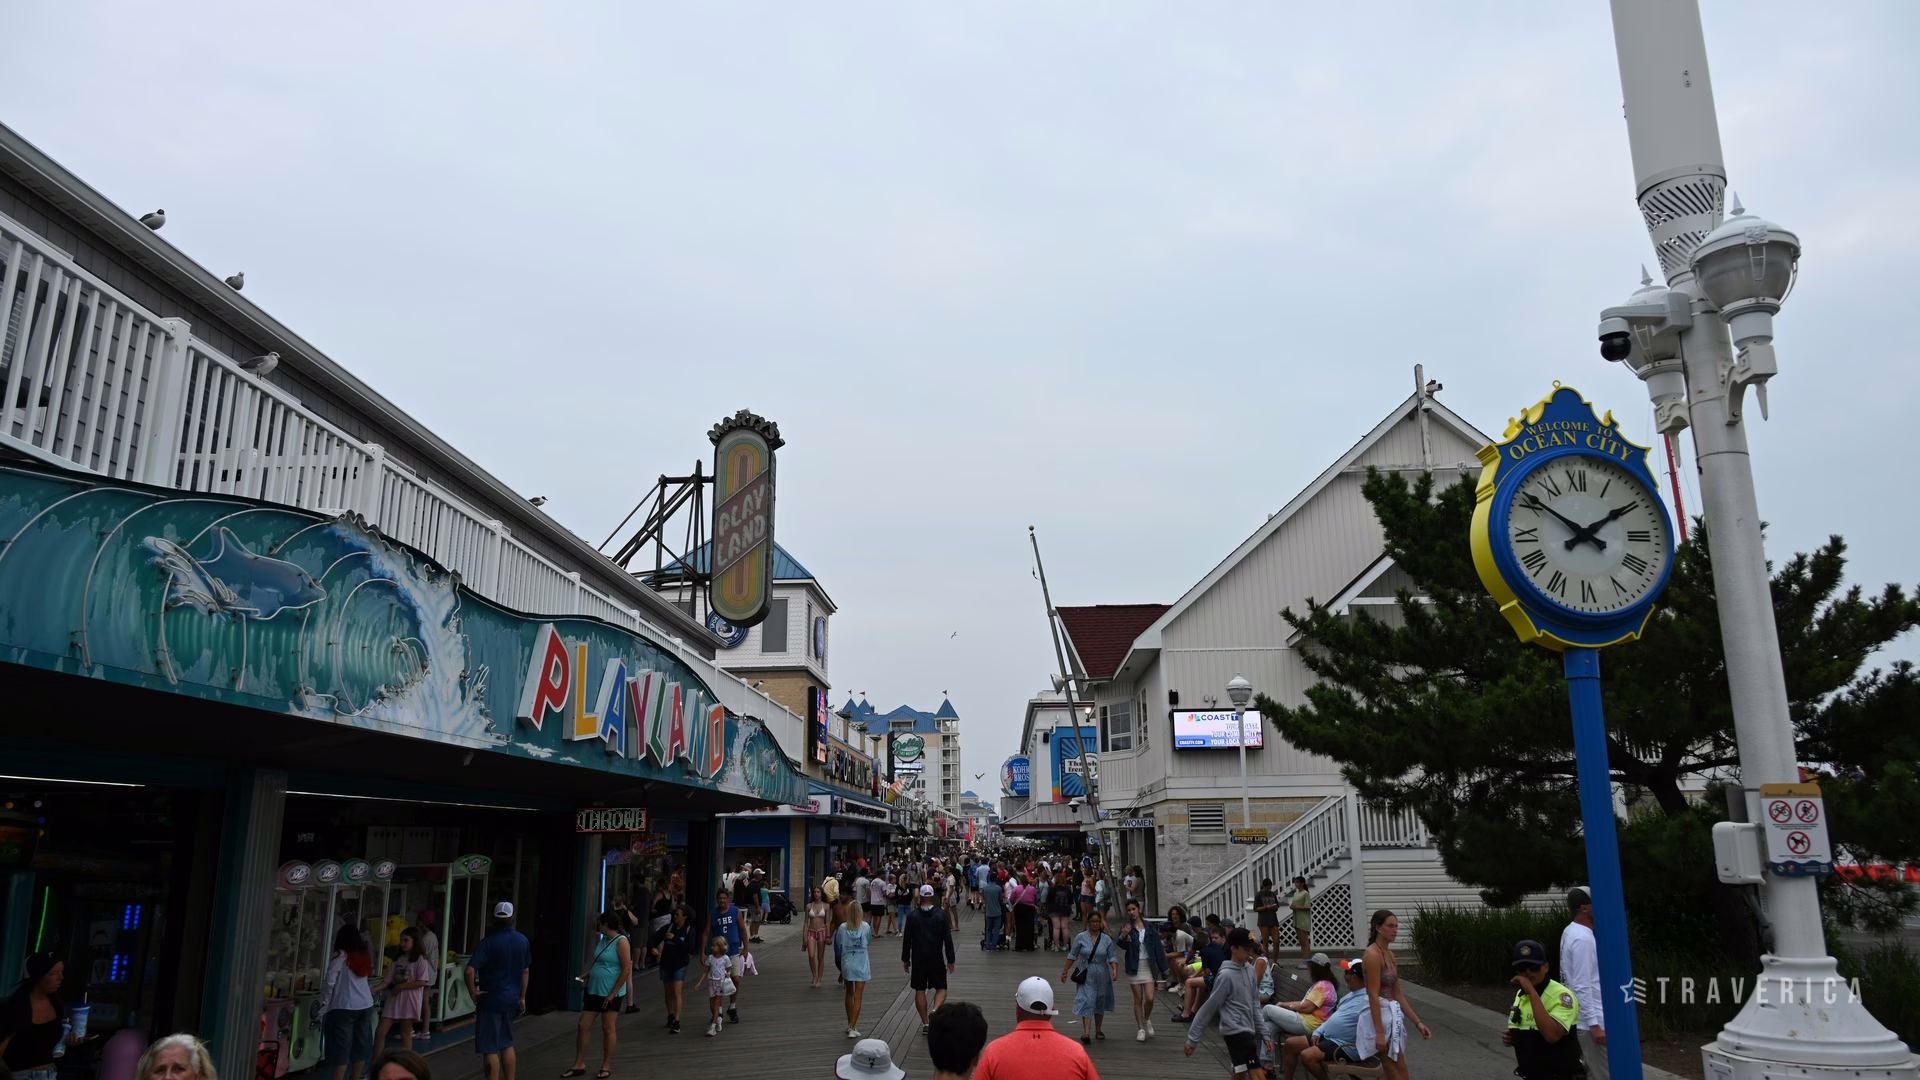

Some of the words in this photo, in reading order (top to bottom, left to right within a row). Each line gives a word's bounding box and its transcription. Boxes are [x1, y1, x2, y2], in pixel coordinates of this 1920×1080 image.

[1525, 421, 1590, 436] WELCOME
[1596, 425, 1613, 438] TO
[1509, 431, 1577, 460] OCEAN
[1586, 434, 1634, 461] CITY
[718, 484, 766, 538] PLAY
[717, 514, 766, 567] LAND
[517, 622, 725, 779] PLAYLAND
[1123, 819, 1154, 827] WOMEN
[717, 916, 733, 925] THE
